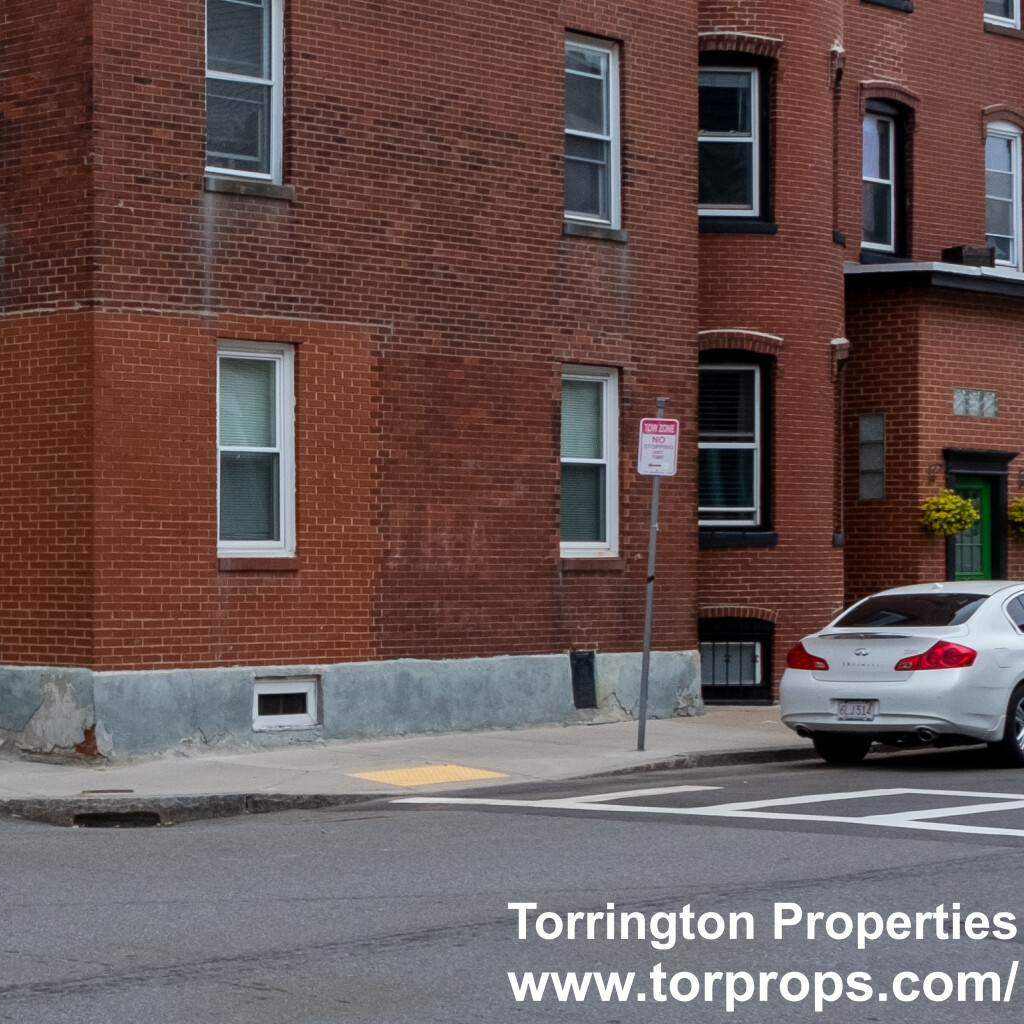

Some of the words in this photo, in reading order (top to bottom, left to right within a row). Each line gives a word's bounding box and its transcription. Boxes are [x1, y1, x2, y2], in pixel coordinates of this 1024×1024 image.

[644, 423, 658, 432] TOW
[658, 424, 675, 433] ZONE
[652, 436, 666, 444] NO
